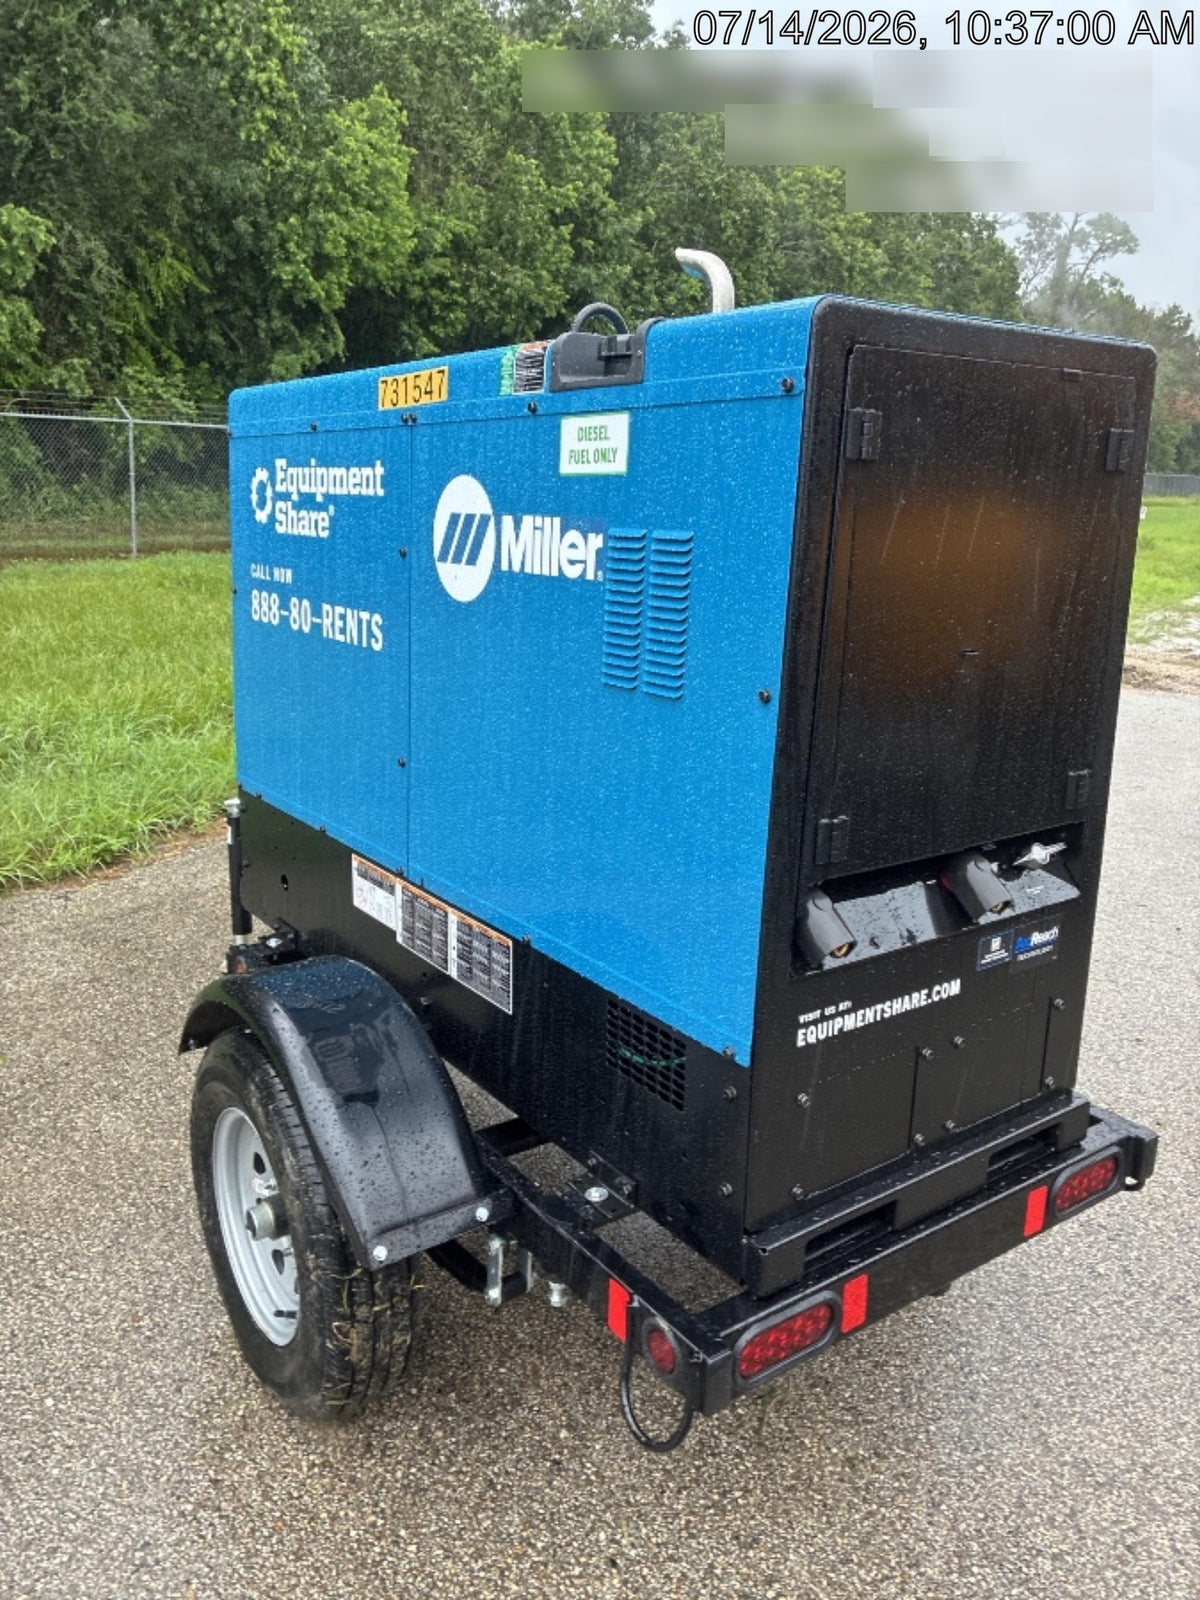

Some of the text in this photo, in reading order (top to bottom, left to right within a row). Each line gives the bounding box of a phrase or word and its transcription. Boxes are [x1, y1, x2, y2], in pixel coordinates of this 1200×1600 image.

[380, 369, 446, 408] 731547
[577, 425, 611, 443] DIESEL
[568, 447, 618, 465] FUEL ONLY
[275, 457, 385, 502] Equipment
[251, 562, 293, 584] CALL NOW
[251, 588, 384, 652] 888-80-RENTS
[796, 978, 962, 1048] EQUIPMENTSHARE.COM
[798, 1009, 822, 1024] VISIT
[824, 1003, 837, 1017] US
